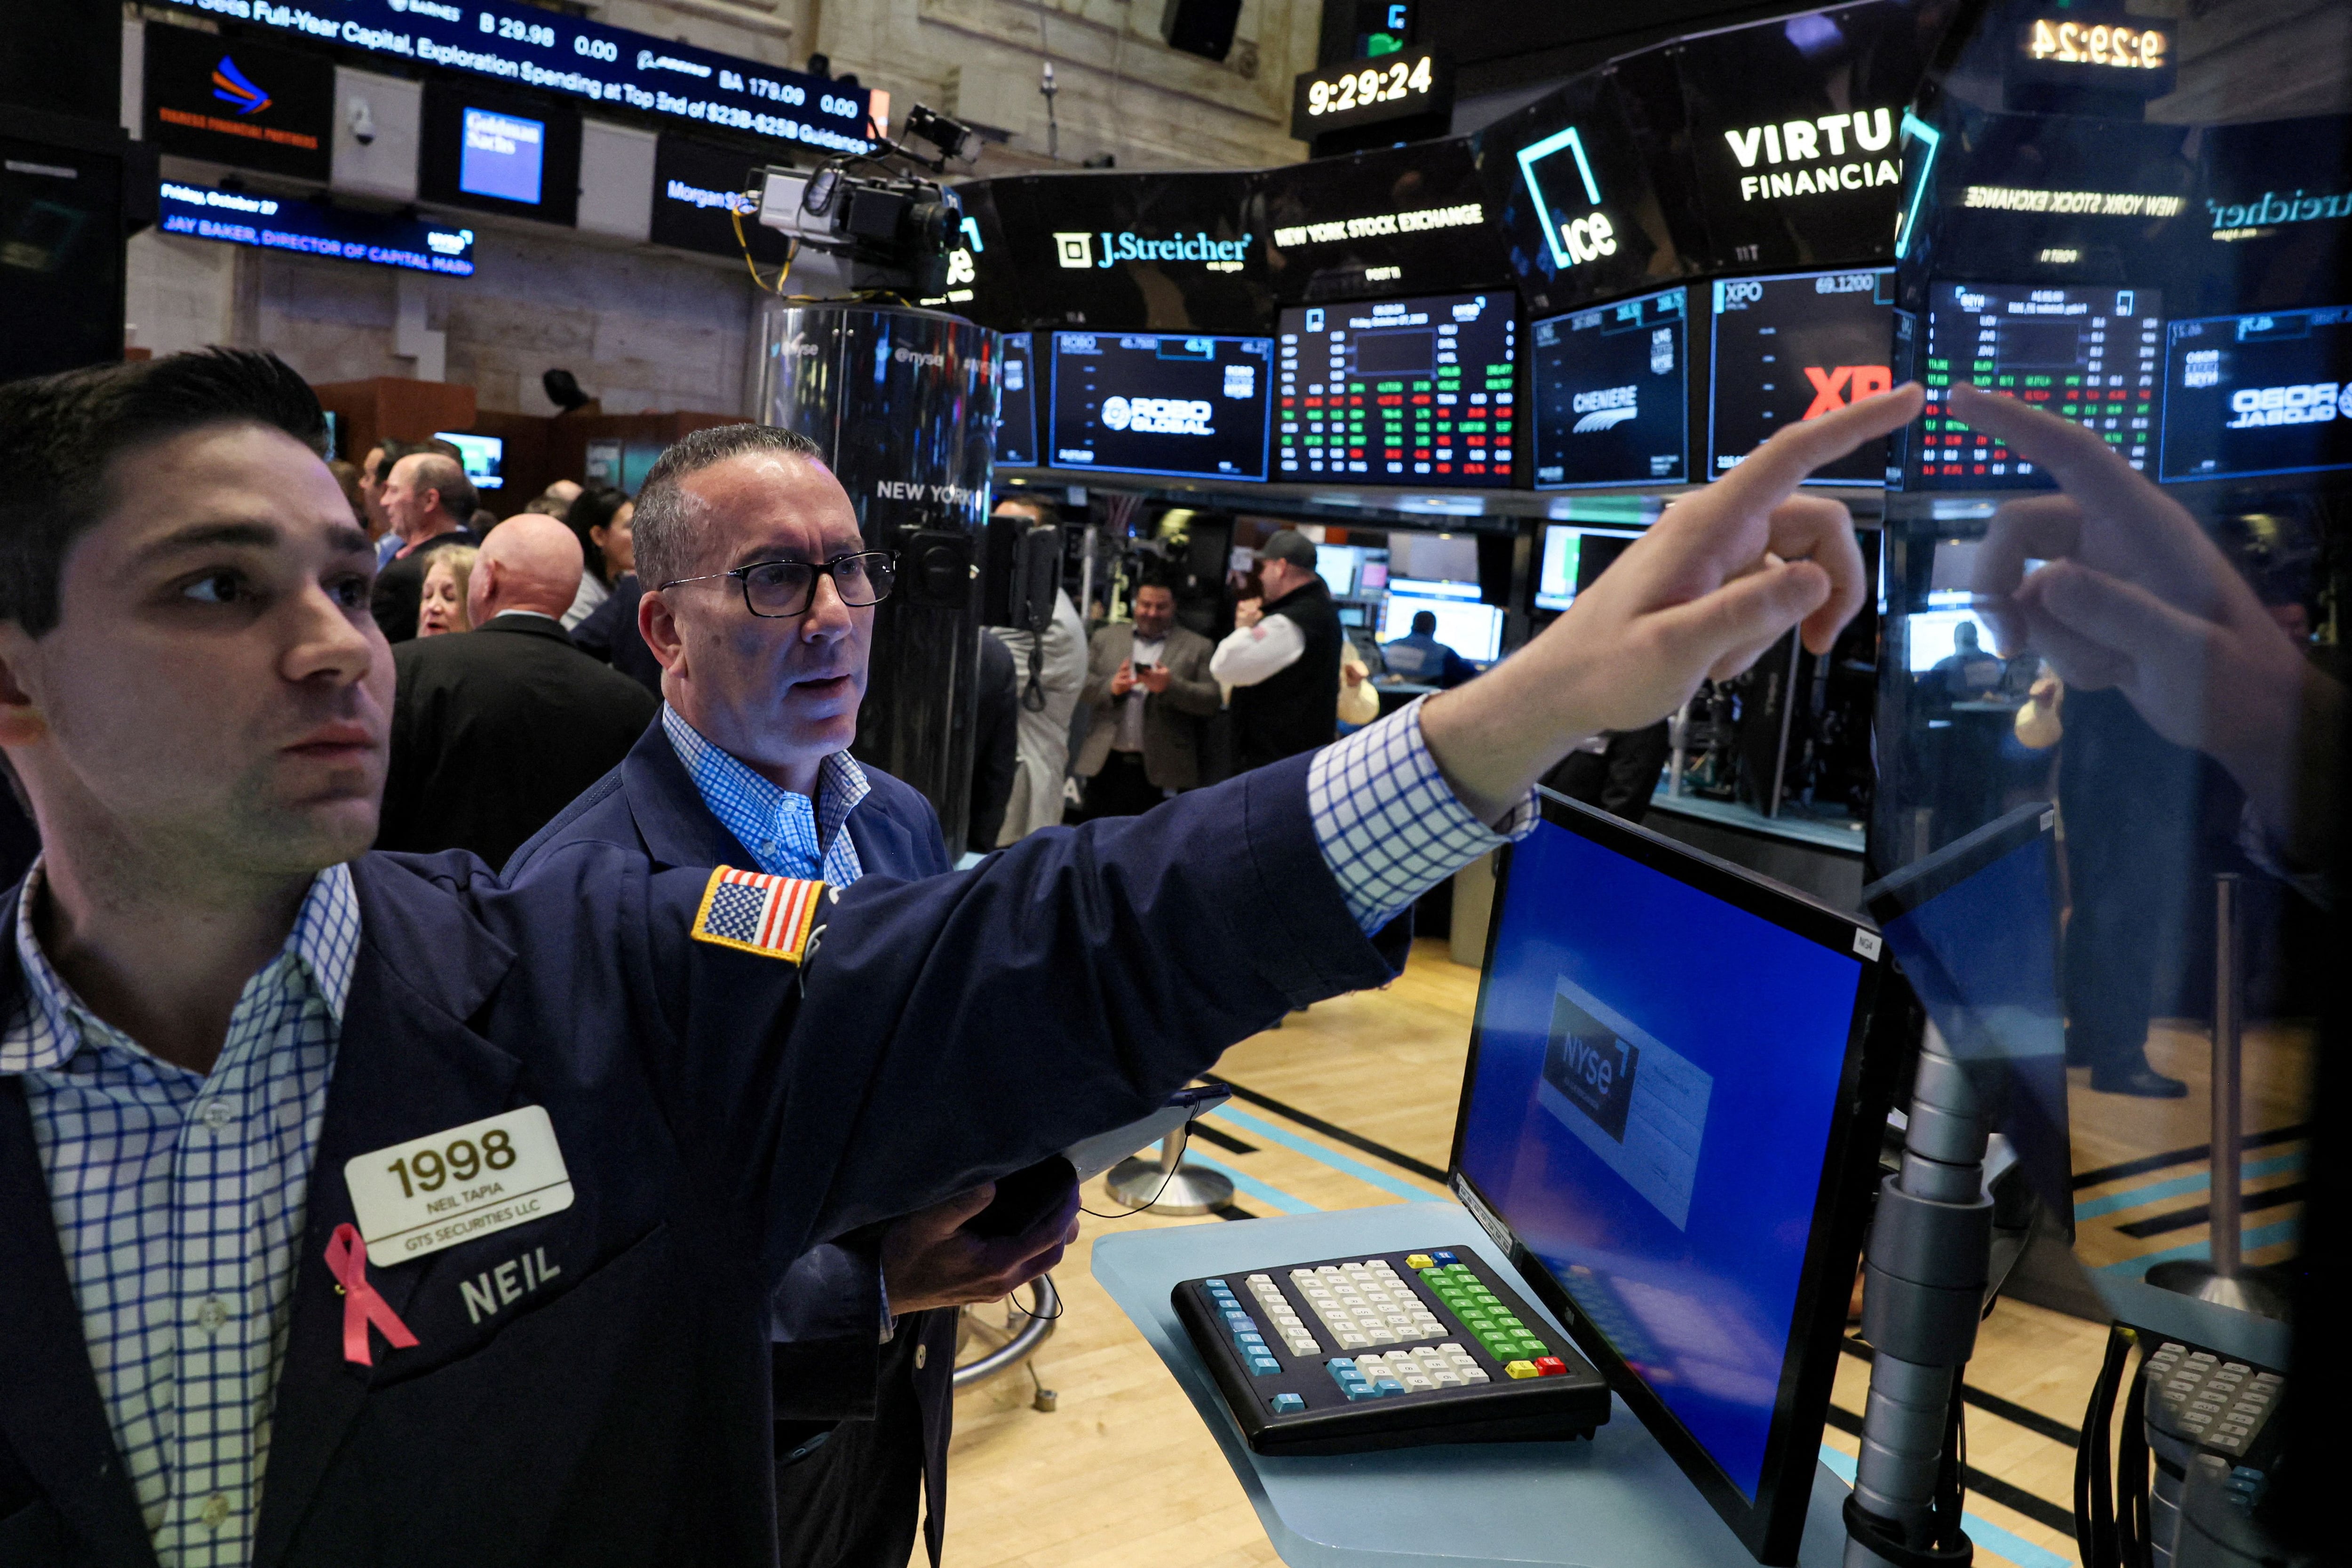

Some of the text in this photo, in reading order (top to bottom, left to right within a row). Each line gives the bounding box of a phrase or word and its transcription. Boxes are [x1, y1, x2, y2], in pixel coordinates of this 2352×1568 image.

[253, 1, 340, 38] Full-Year
[342, 21, 414, 56] Capital,
[417, 37, 518, 78] Exploration
[520, 61, 602, 99] Spending
[604, 83, 621, 101] at
[622, 83, 655, 110] Top
[656, 91, 687, 115] End
[688, 101, 707, 119] of
[799, 124, 868, 155] Guidance
[480, 12, 494, 33] B
[574, 35, 617, 62] 0.00
[719, 70, 744, 92] BA
[820, 95, 858, 118] 0.00
[1308, 56, 1432, 115] 9:29:24
[1724, 107, 1891, 167] VIRTU
[667, 179, 725, 208] Morgan
[1740, 158, 1903, 201] FINANCIA
[207, 191, 260, 212] October
[163, 214, 197, 233] JAY
[261, 229, 342, 256] DIRECTOR
[342, 242, 367, 258] OF
[367, 246, 430, 270] CAPITAL
[1274, 203, 1484, 247] NEW YORK STOCK EXCHANGE
[1098, 231, 1247, 268] J.Streicher
[1725, 281, 1763, 302] XPO
[894, 347, 944, 367] @nyse
[1130, 397, 1212, 422] ROBO
[1803, 365, 1893, 421] XP
[1130, 418, 1213, 435] GLOBAL
[877, 480, 973, 506] NEW YORK
[387, 1128, 517, 1198] 1998
[427, 1182, 504, 1215] NEIL TAPIA
[404, 1199, 541, 1253] GTS SECURITIES LLC
[459, 1246, 561, 1324] NEIL
